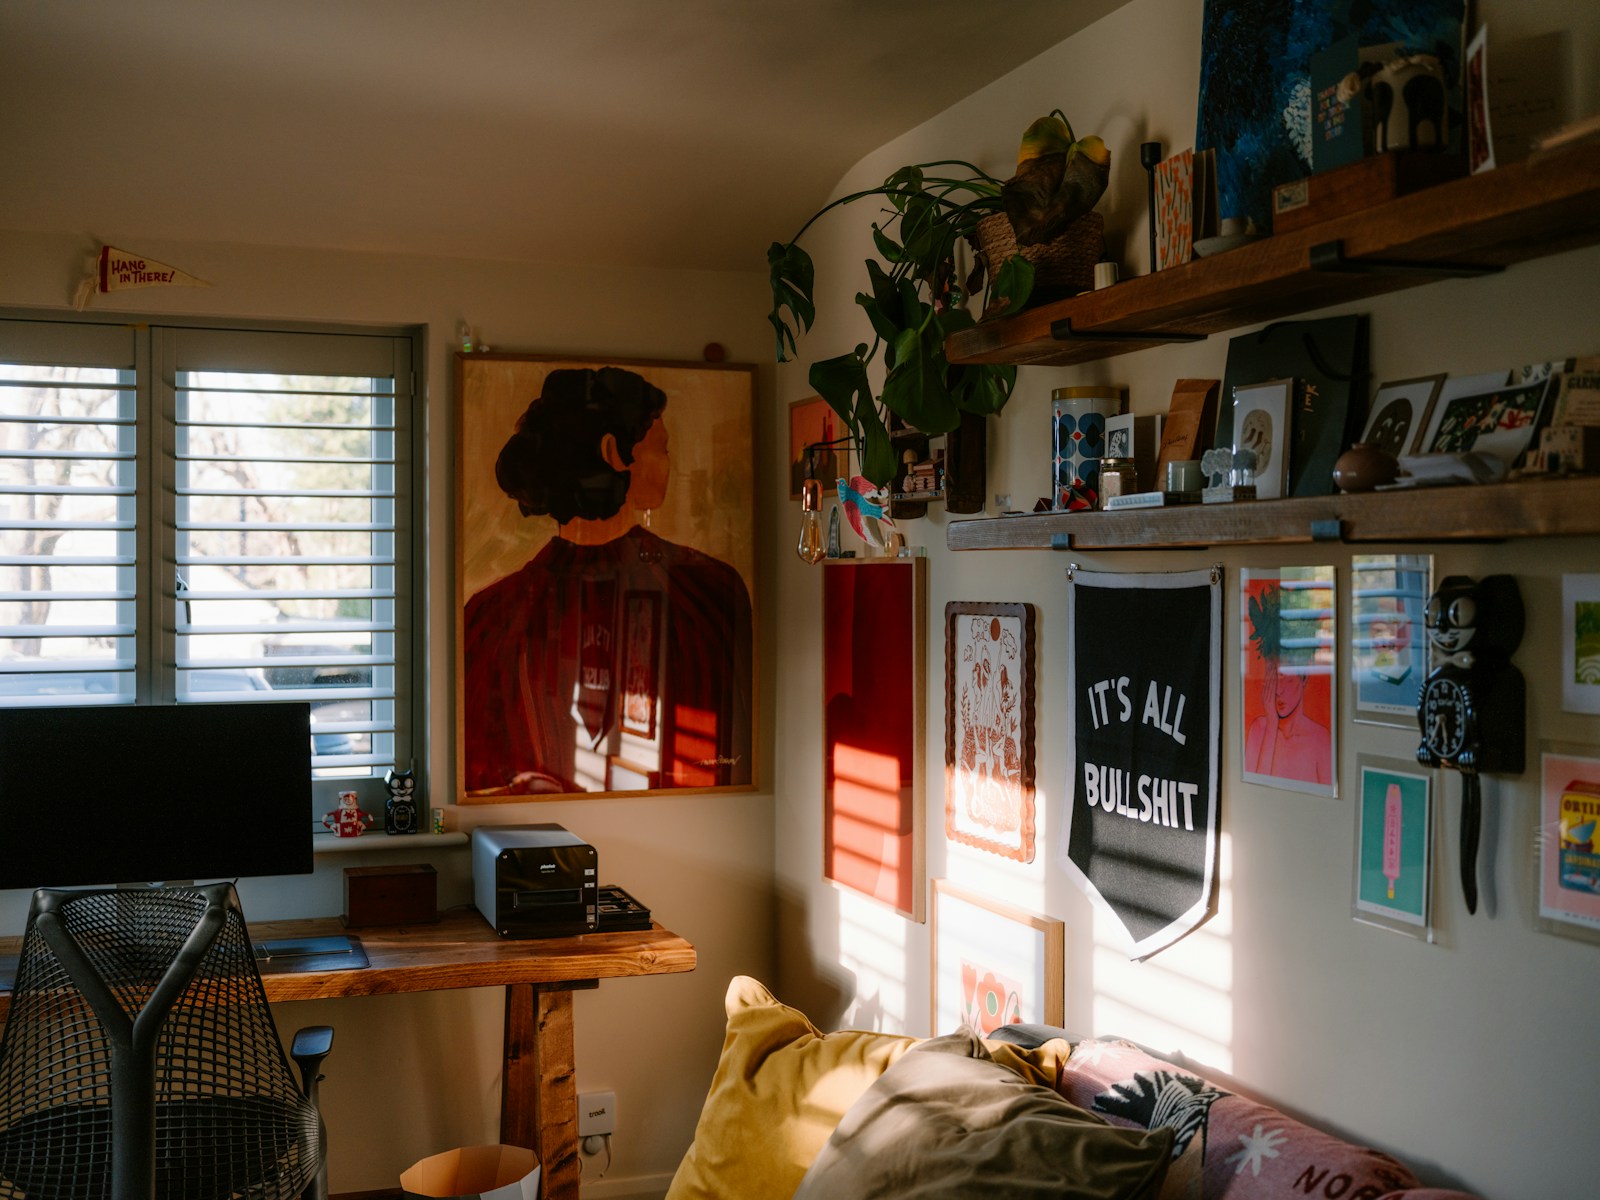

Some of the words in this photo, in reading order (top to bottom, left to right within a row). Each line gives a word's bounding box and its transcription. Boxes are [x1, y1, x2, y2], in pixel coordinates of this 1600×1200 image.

[111, 259, 146, 275] HANG
[119, 273, 131, 283] IN
[131, 270, 175, 284] THERE!
[1088, 676, 1132, 730] IT'S
[1142, 680, 1187, 746] ALL
[1084, 762, 1199, 831] BULLSHIT
